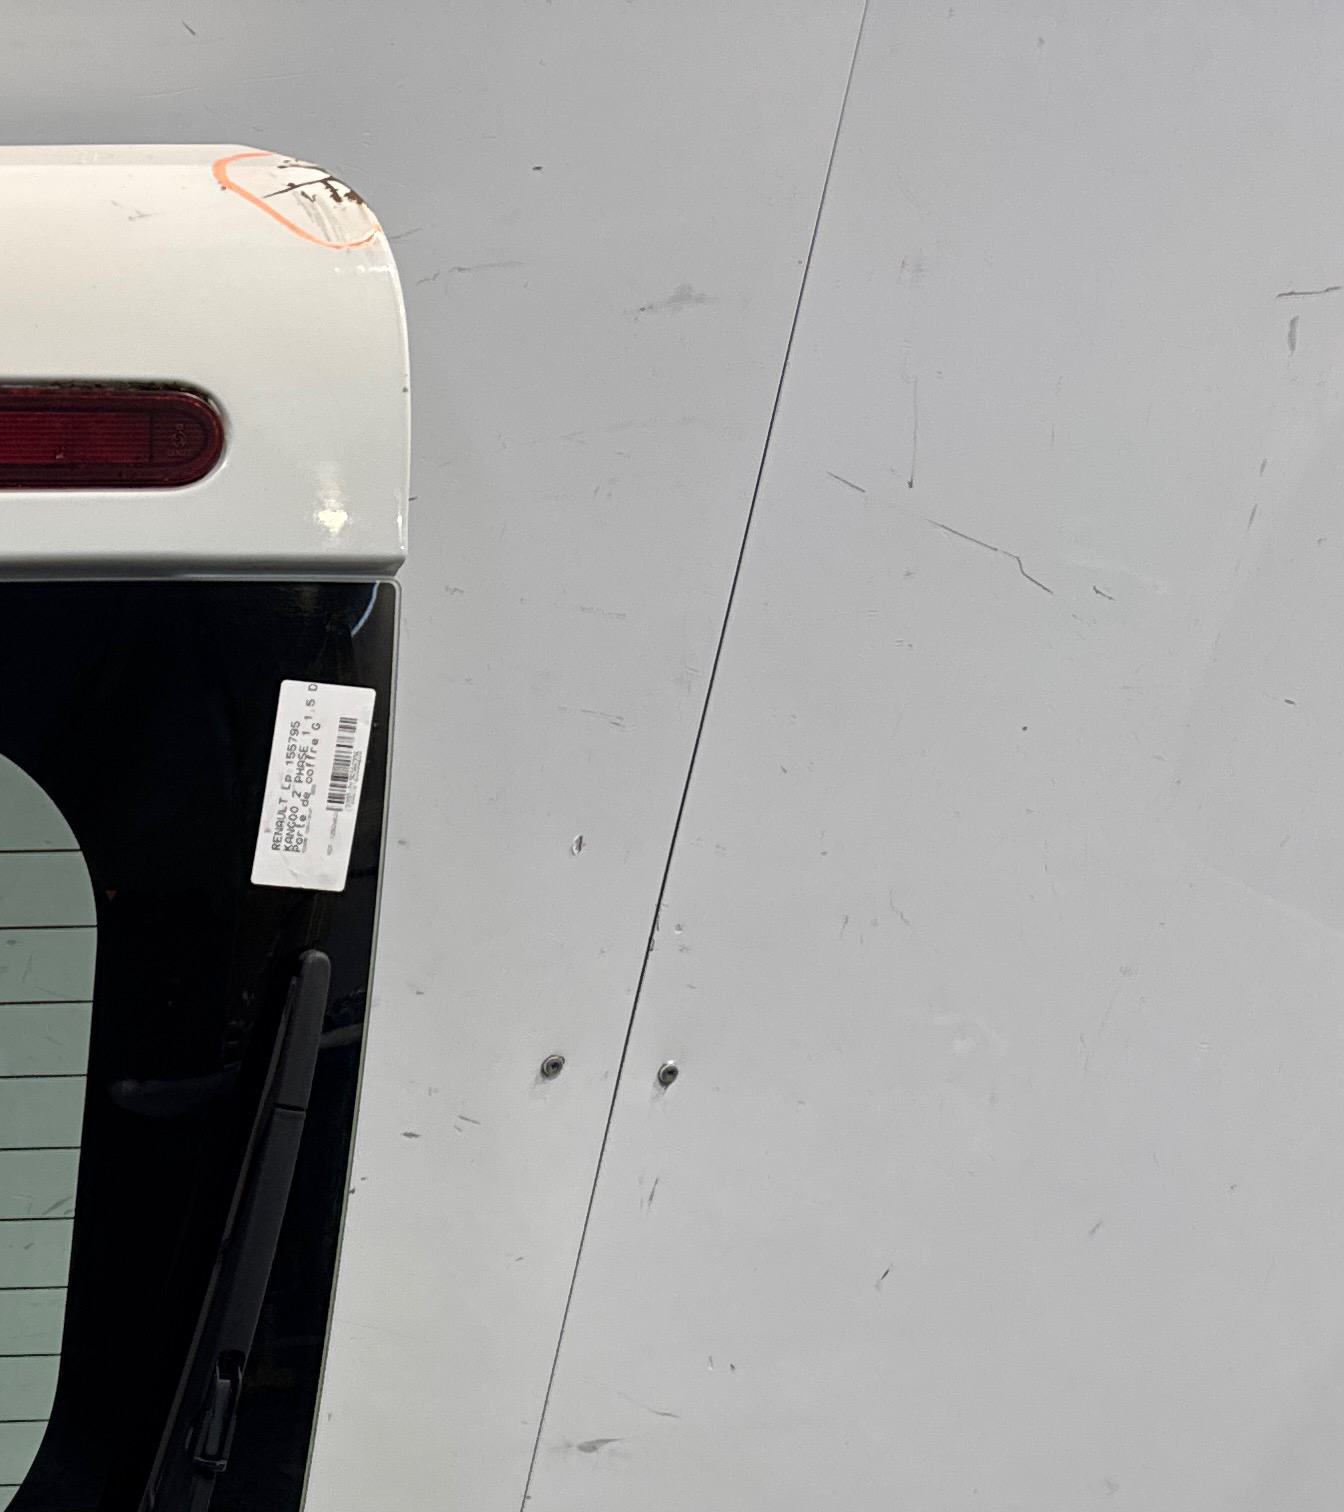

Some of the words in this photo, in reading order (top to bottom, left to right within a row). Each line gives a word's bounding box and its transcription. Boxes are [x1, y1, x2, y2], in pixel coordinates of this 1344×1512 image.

[308, 684, 318, 692] D
[311, 722, 321, 731] G
[294, 745, 309, 784] PHASE
[306, 738, 319, 784] coffre
[271, 797, 289, 851] RENAULT
[286, 721, 301, 765] 155795
[292, 790, 302, 798] 2
[302, 792, 312, 807] de
[283, 806, 299, 852] KANGOO
[291, 814, 307, 852] Porte
